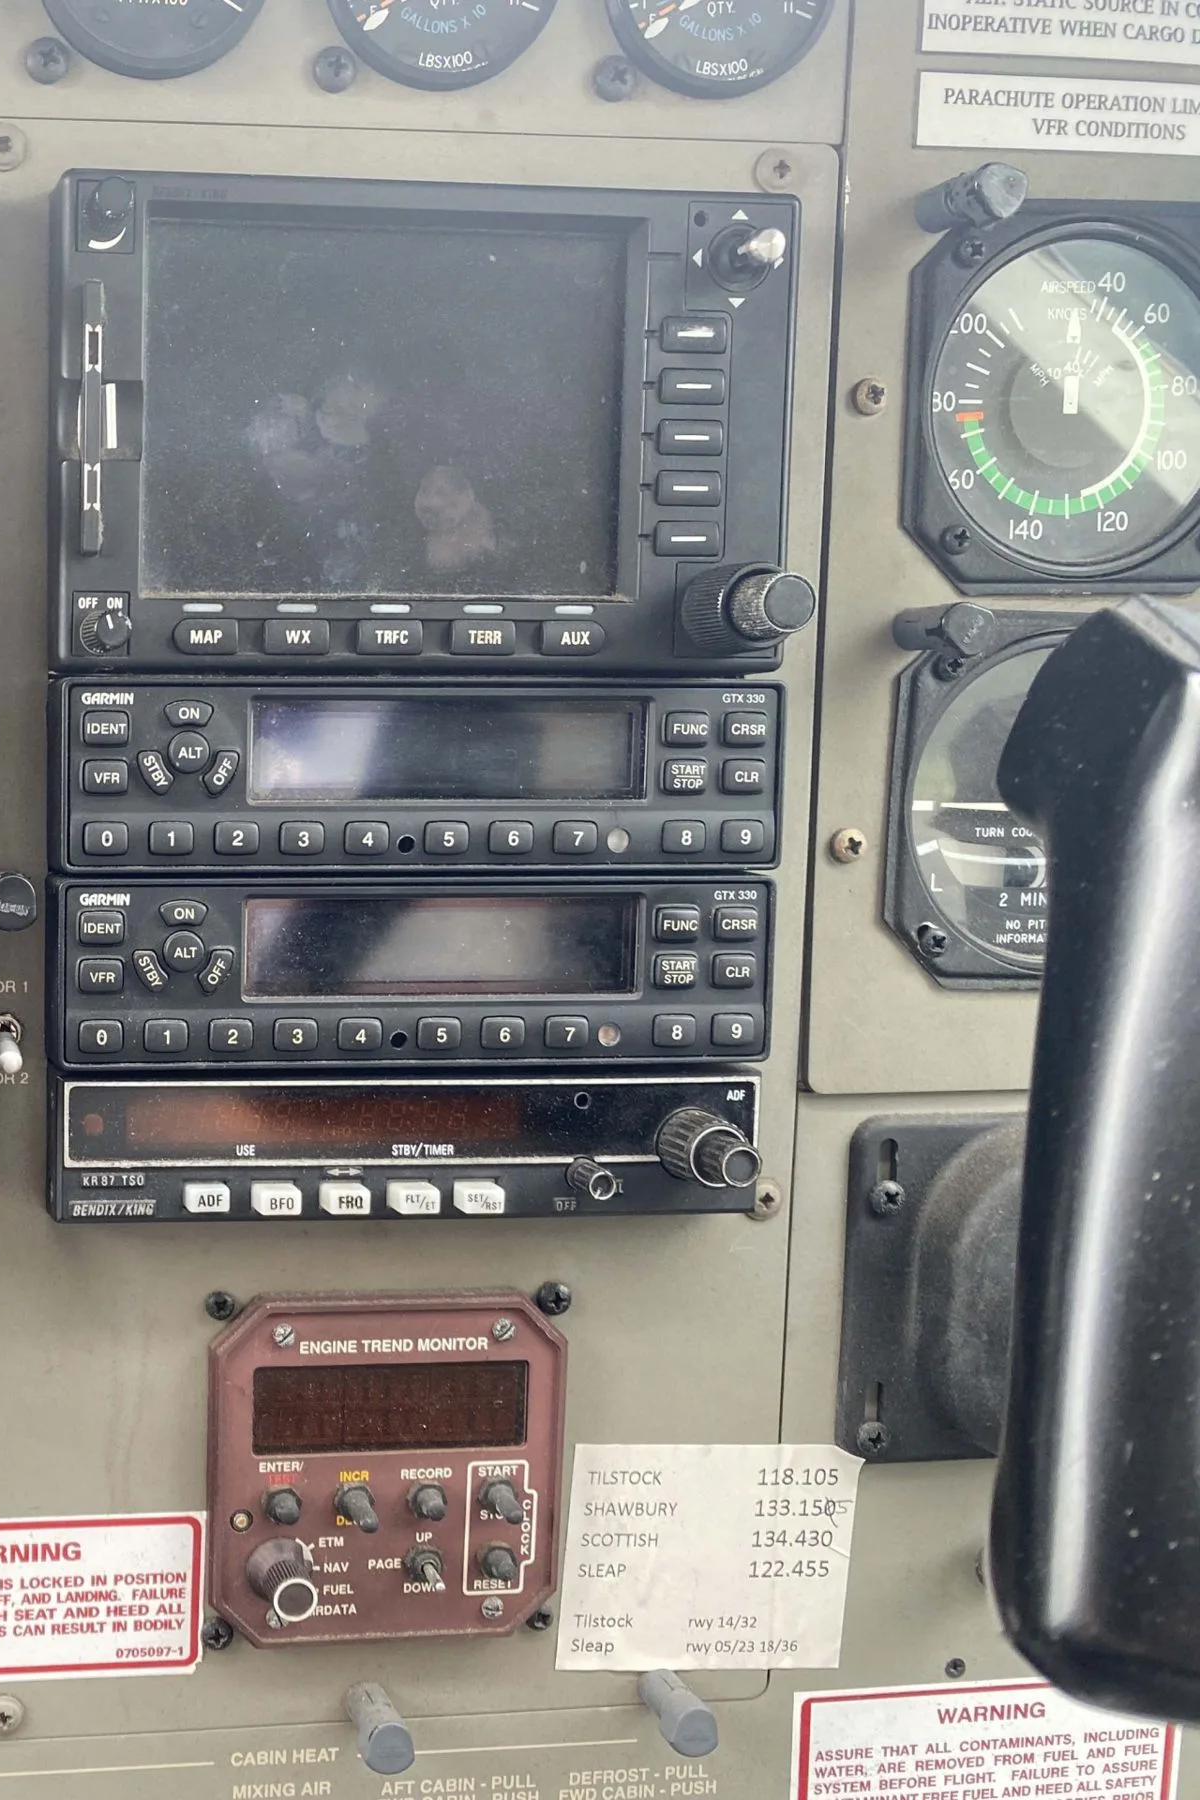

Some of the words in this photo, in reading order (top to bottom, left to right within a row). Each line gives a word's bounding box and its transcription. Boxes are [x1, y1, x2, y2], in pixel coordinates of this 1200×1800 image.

[927, 13, 1052, 35] INOPERATIVE
[1060, 20, 1116, 38] WHEN
[1123, 23, 1184, 43] CARGO
[943, 87, 1054, 108] PARACHUTE
[1062, 92, 1165, 113] OPERATION
[1032, 118, 1068, 136] VFR
[1075, 120, 1186, 140] CONDITIONS
[1157, 450, 1187, 470] 100
[1097, 511, 1128, 532] 120
[1009, 519, 1043, 540] 140
[190, 630, 223, 644] MAP
[285, 630, 310, 644] WX
[375, 630, 409, 645] TRFC
[469, 630, 502, 645] TERR
[561, 631, 590, 645] AUX
[82, 693, 133, 705] GARMIN
[722, 694, 743, 703] GTX
[746, 694, 765, 703] 330
[179, 708, 200, 719] ON
[87, 724, 126, 734] IDENT
[673, 724, 708, 735] FUNC
[732, 724, 765, 735] CRSR
[178, 747, 202, 758] ALT
[94, 773, 120, 784] VFR
[735, 772, 758, 783] CLR
[391, 1144, 454, 1156] STBY/TIMER
[83, 1176, 98, 1187] KR
[101, 1175, 115, 1186] 87
[121, 1176, 144, 1187] TSO
[198, 1195, 223, 1207] ADF
[270, 1197, 294, 1210] BFO
[73, 1204, 153, 1217] BENDIX/KING
[300, 1340, 357, 1354] ENGINE
[362, 1339, 413, 1352] TREND
[418, 1337, 488, 1351] MONITOR
[401, 1468, 452, 1480] RECORD
[478, 1466, 518, 1477] START
[588, 1471, 662, 1486] TILSTOCK
[757, 1468, 839, 1487] 118.105
[584, 1502, 678, 1517] SHAWBURY
[581, 1533, 658, 1548] SCOTTISH
[751, 1531, 833, 1548] 134.430
[368, 1558, 402, 1569] PAGE
[578, 1564, 627, 1578] SLEAP
[749, 1561, 829, 1578] 122.455
[20, 1575, 84, 1590] LOCKED
[91, 1574, 107, 1586] IN
[113, 1572, 187, 1586] POSITION
[323, 1584, 354, 1595] FUEL
[13, 1624, 46, 1637] CAN
[51, 1621, 106, 1635] RESULT
[113, 1620, 128, 1632] IN
[133, 1617, 184, 1632] BODILY
[574, 1614, 633, 1628] Tilstock
[688, 1618, 713, 1630] rwy
[718, 1616, 757, 1630] 14/32
[116, 1646, 183, 1659] 0705097-1
[571, 1639, 614, 1653] Sleap
[686, 1642, 711, 1655] rwy
[714, 1640, 754, 1653] 05/23
[760, 1639, 798, 1653] 18/36
[937, 1702, 1045, 1724] WARNING
[815, 1748, 873, 1762] ASSURE
[882, 1745, 917, 1758] THAT
[925, 1742, 951, 1754] ALL
[959, 1733, 1075, 1752] CONTAMINANTS,
[1084, 1728, 1159, 1743] INCLUDING
[231, 1750, 287, 1767] CABIN
[292, 1747, 338, 1764] HEAT
[569, 1769, 649, 1786] DEFROST
[665, 1765, 708, 1781] PULL
